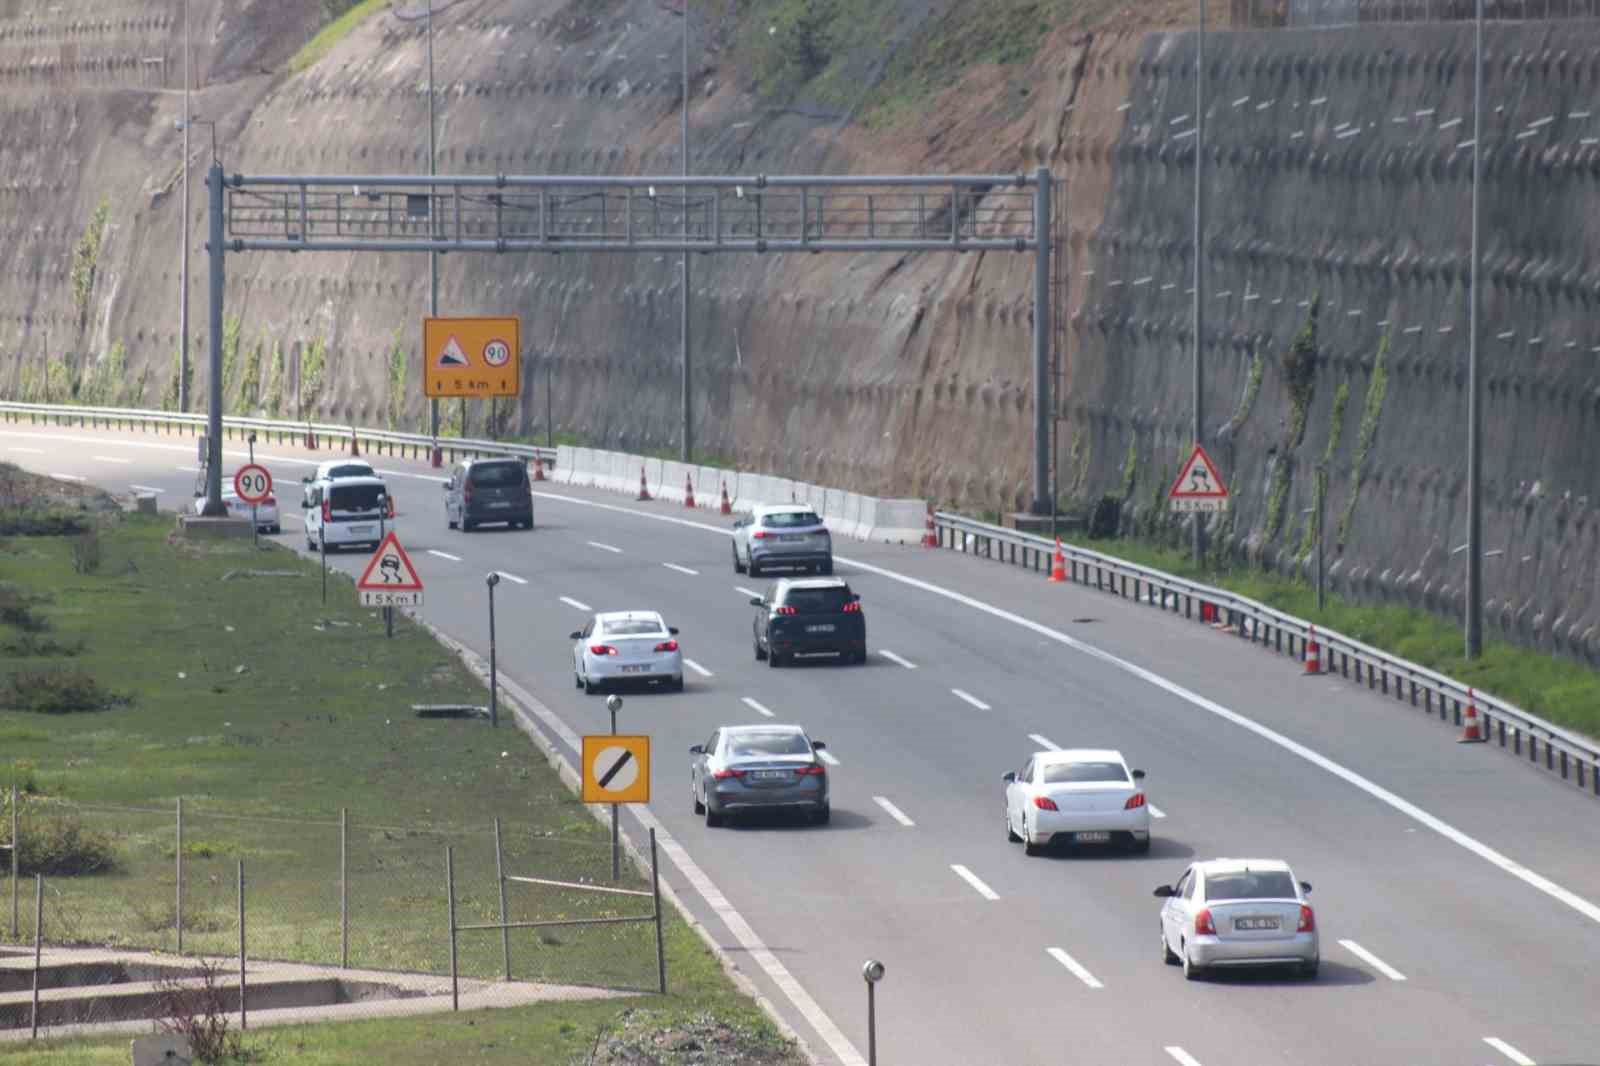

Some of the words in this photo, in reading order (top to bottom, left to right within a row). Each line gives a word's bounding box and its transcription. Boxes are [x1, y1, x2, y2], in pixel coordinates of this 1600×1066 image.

[487, 346, 506, 361] 90
[242, 474, 265, 492] 90
[375, 593, 384, 605] 5
